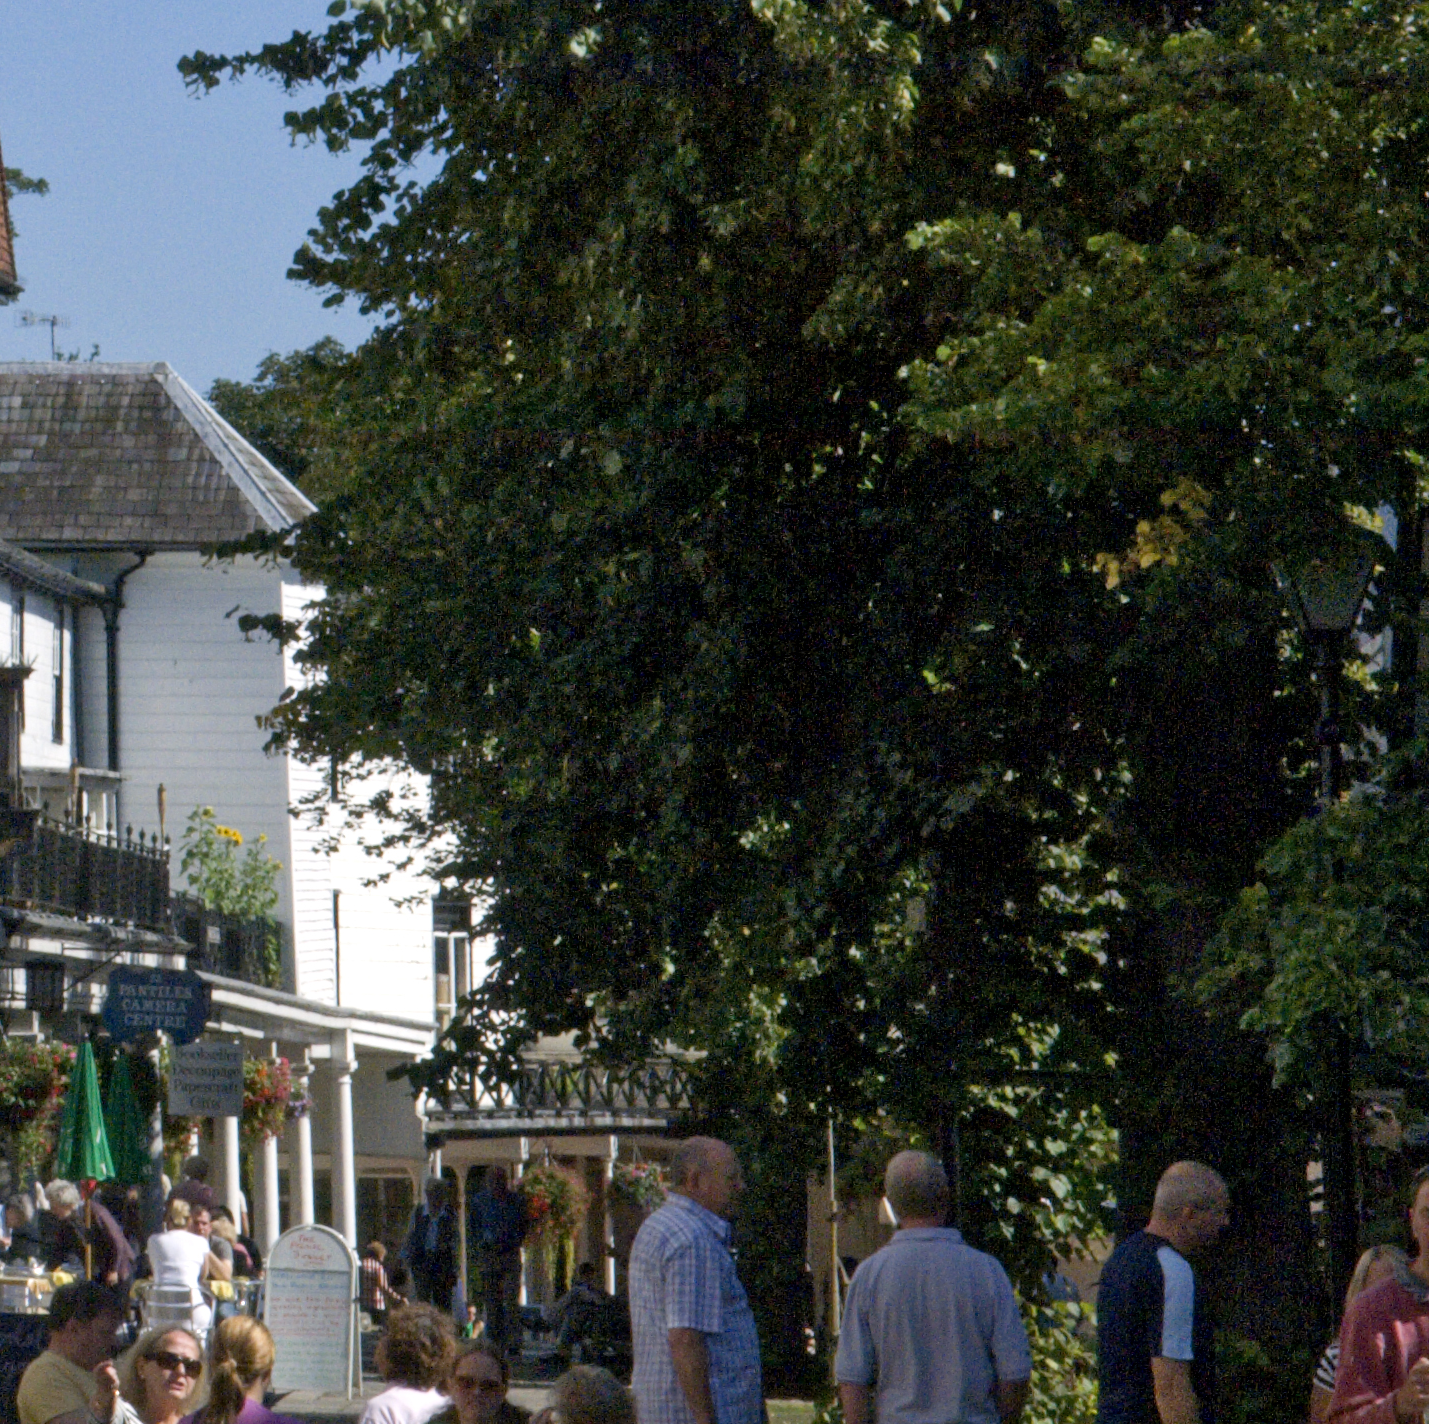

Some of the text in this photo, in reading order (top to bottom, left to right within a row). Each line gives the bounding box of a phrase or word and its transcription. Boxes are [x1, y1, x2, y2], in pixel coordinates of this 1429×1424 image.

[119, 984, 193, 999] PANTILES
[122, 998, 188, 1013] CAMERA
[124, 1013, 186, 1028] CENTRE
